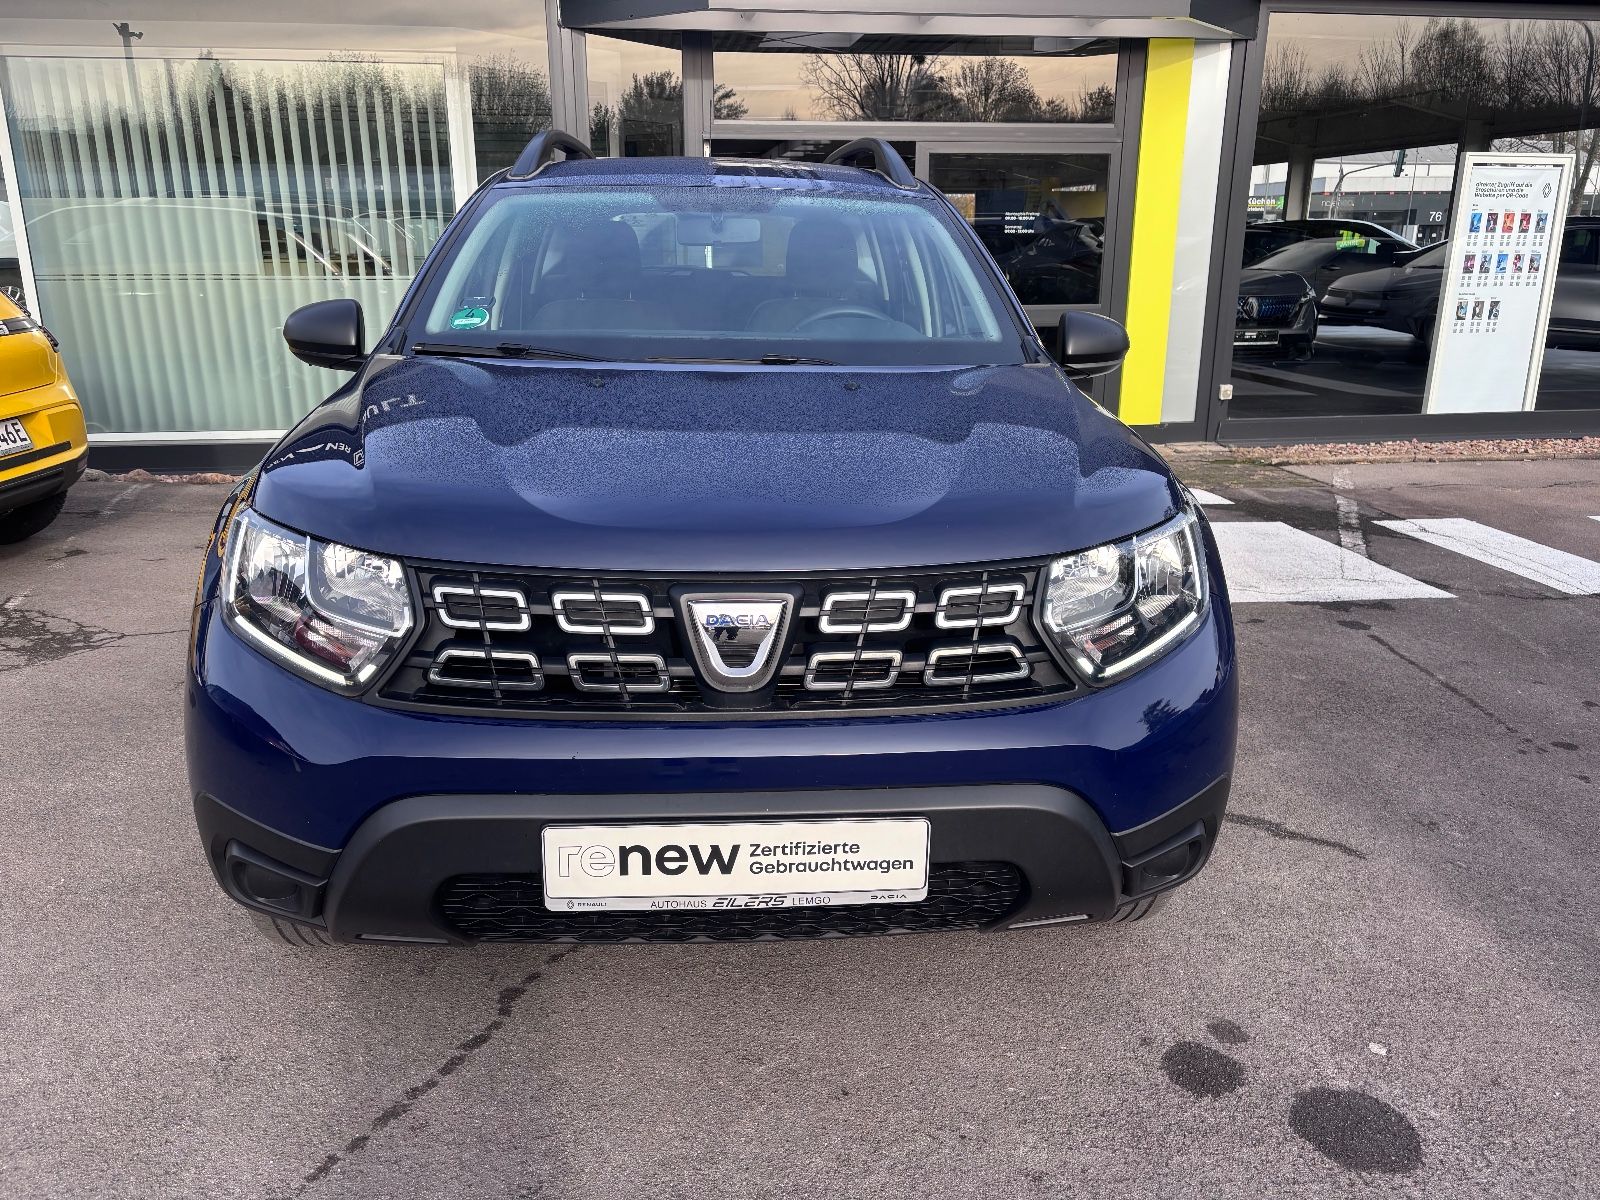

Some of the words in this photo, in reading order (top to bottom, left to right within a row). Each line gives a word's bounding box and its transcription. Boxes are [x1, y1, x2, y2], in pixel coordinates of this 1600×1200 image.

[1429, 211, 1443, 222] 76
[464, 308, 475, 319] 4
[0, 421, 28, 447] 46E
[705, 613, 769, 627] DACIA
[749, 841, 861, 858] Zertifizierte
[558, 844, 741, 877] renew
[749, 858, 914, 875] Gebrauchtwagen
[650, 899, 707, 909] AUTOHAUS
[712, 896, 788, 908] EILERS
[792, 896, 831, 906] LEMGO
